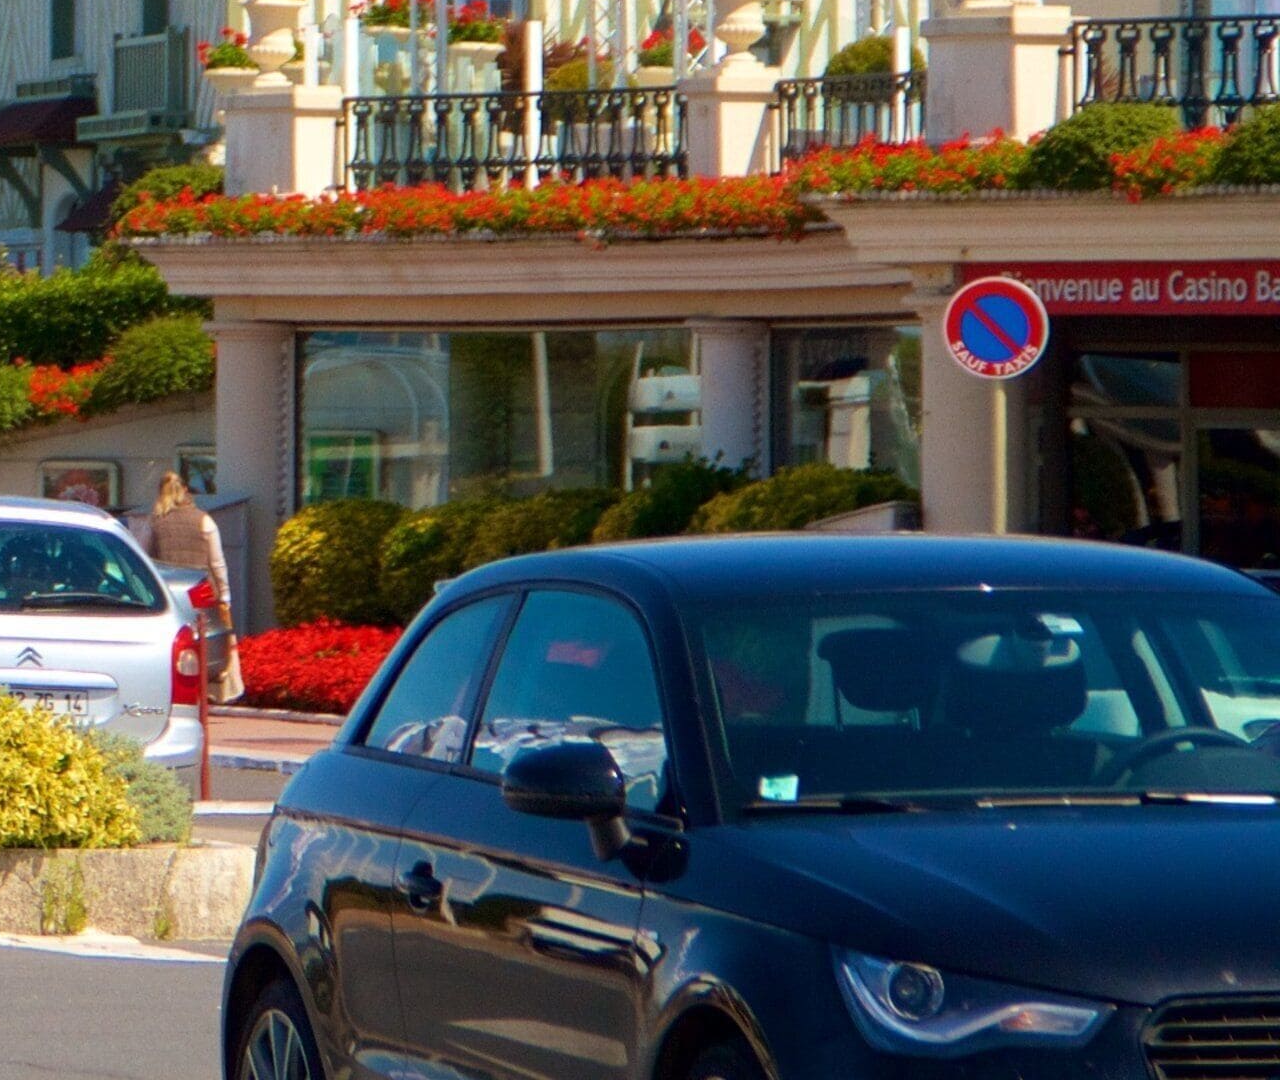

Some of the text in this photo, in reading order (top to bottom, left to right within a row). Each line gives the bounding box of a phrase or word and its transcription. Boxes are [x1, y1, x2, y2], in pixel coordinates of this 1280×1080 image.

[1130, 277, 1159, 302] au
[1169, 270, 1247, 302] Casino
[952, 340, 1038, 375] SAUF TAXIS
[64, 694, 82, 713] 14
